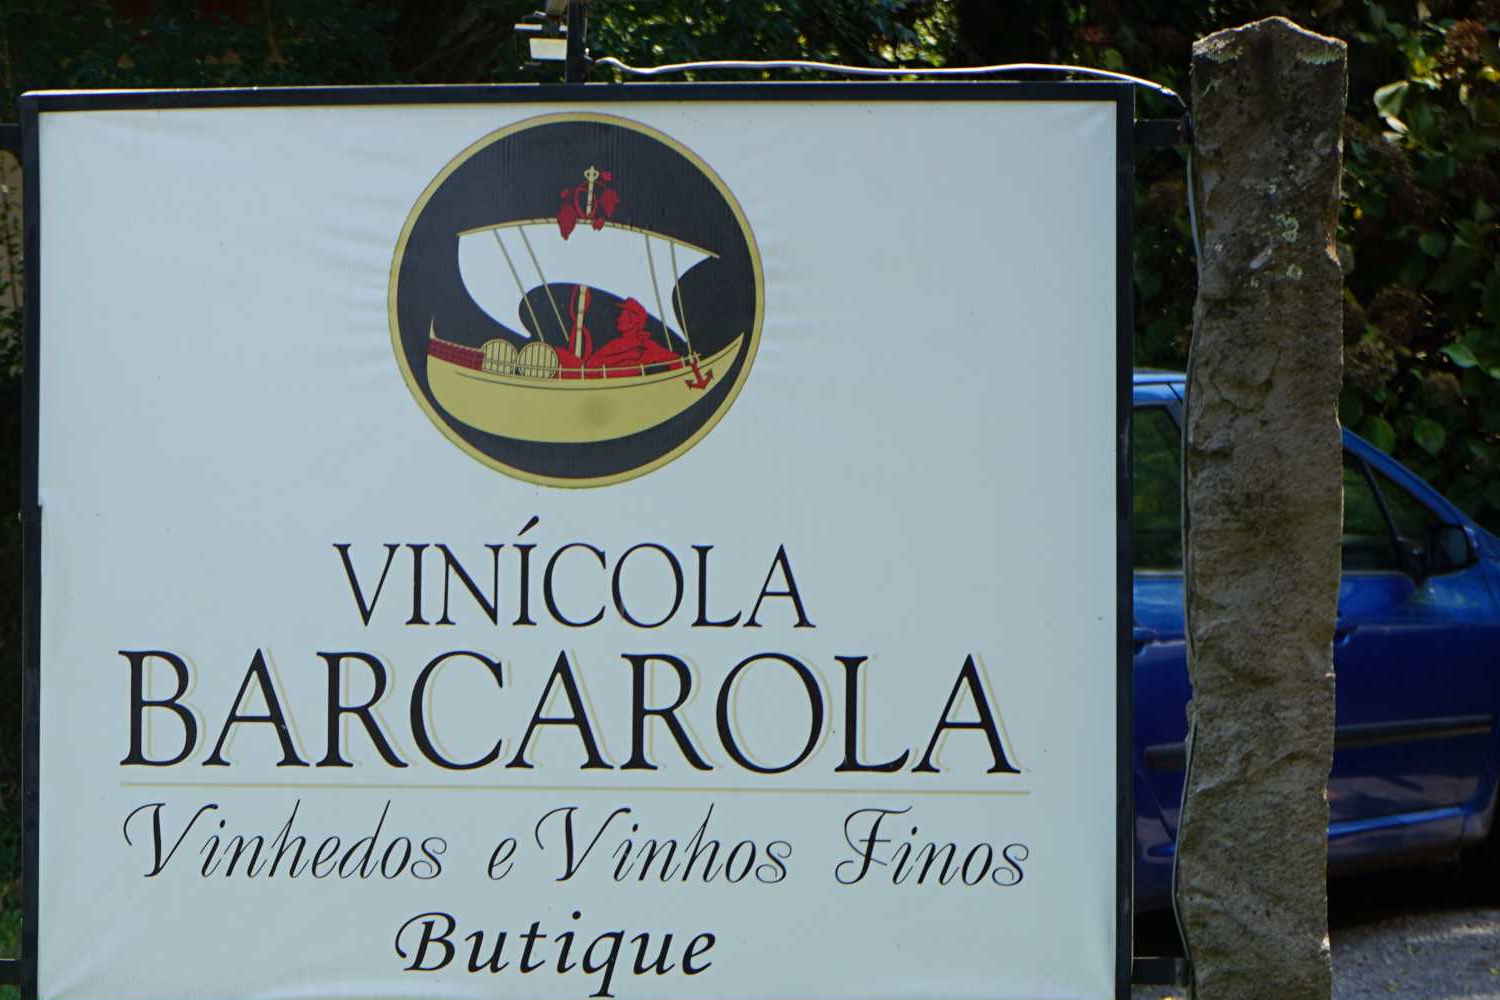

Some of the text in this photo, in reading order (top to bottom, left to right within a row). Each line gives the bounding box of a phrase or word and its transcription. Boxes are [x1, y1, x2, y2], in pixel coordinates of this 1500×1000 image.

[332, 514, 817, 629] VINÍCOLA
[117, 648, 1023, 776] BARCAROLA
[122, 799, 1032, 888] Vinhedos e Vinhos Finos
[393, 910, 717, 1000] Butique
